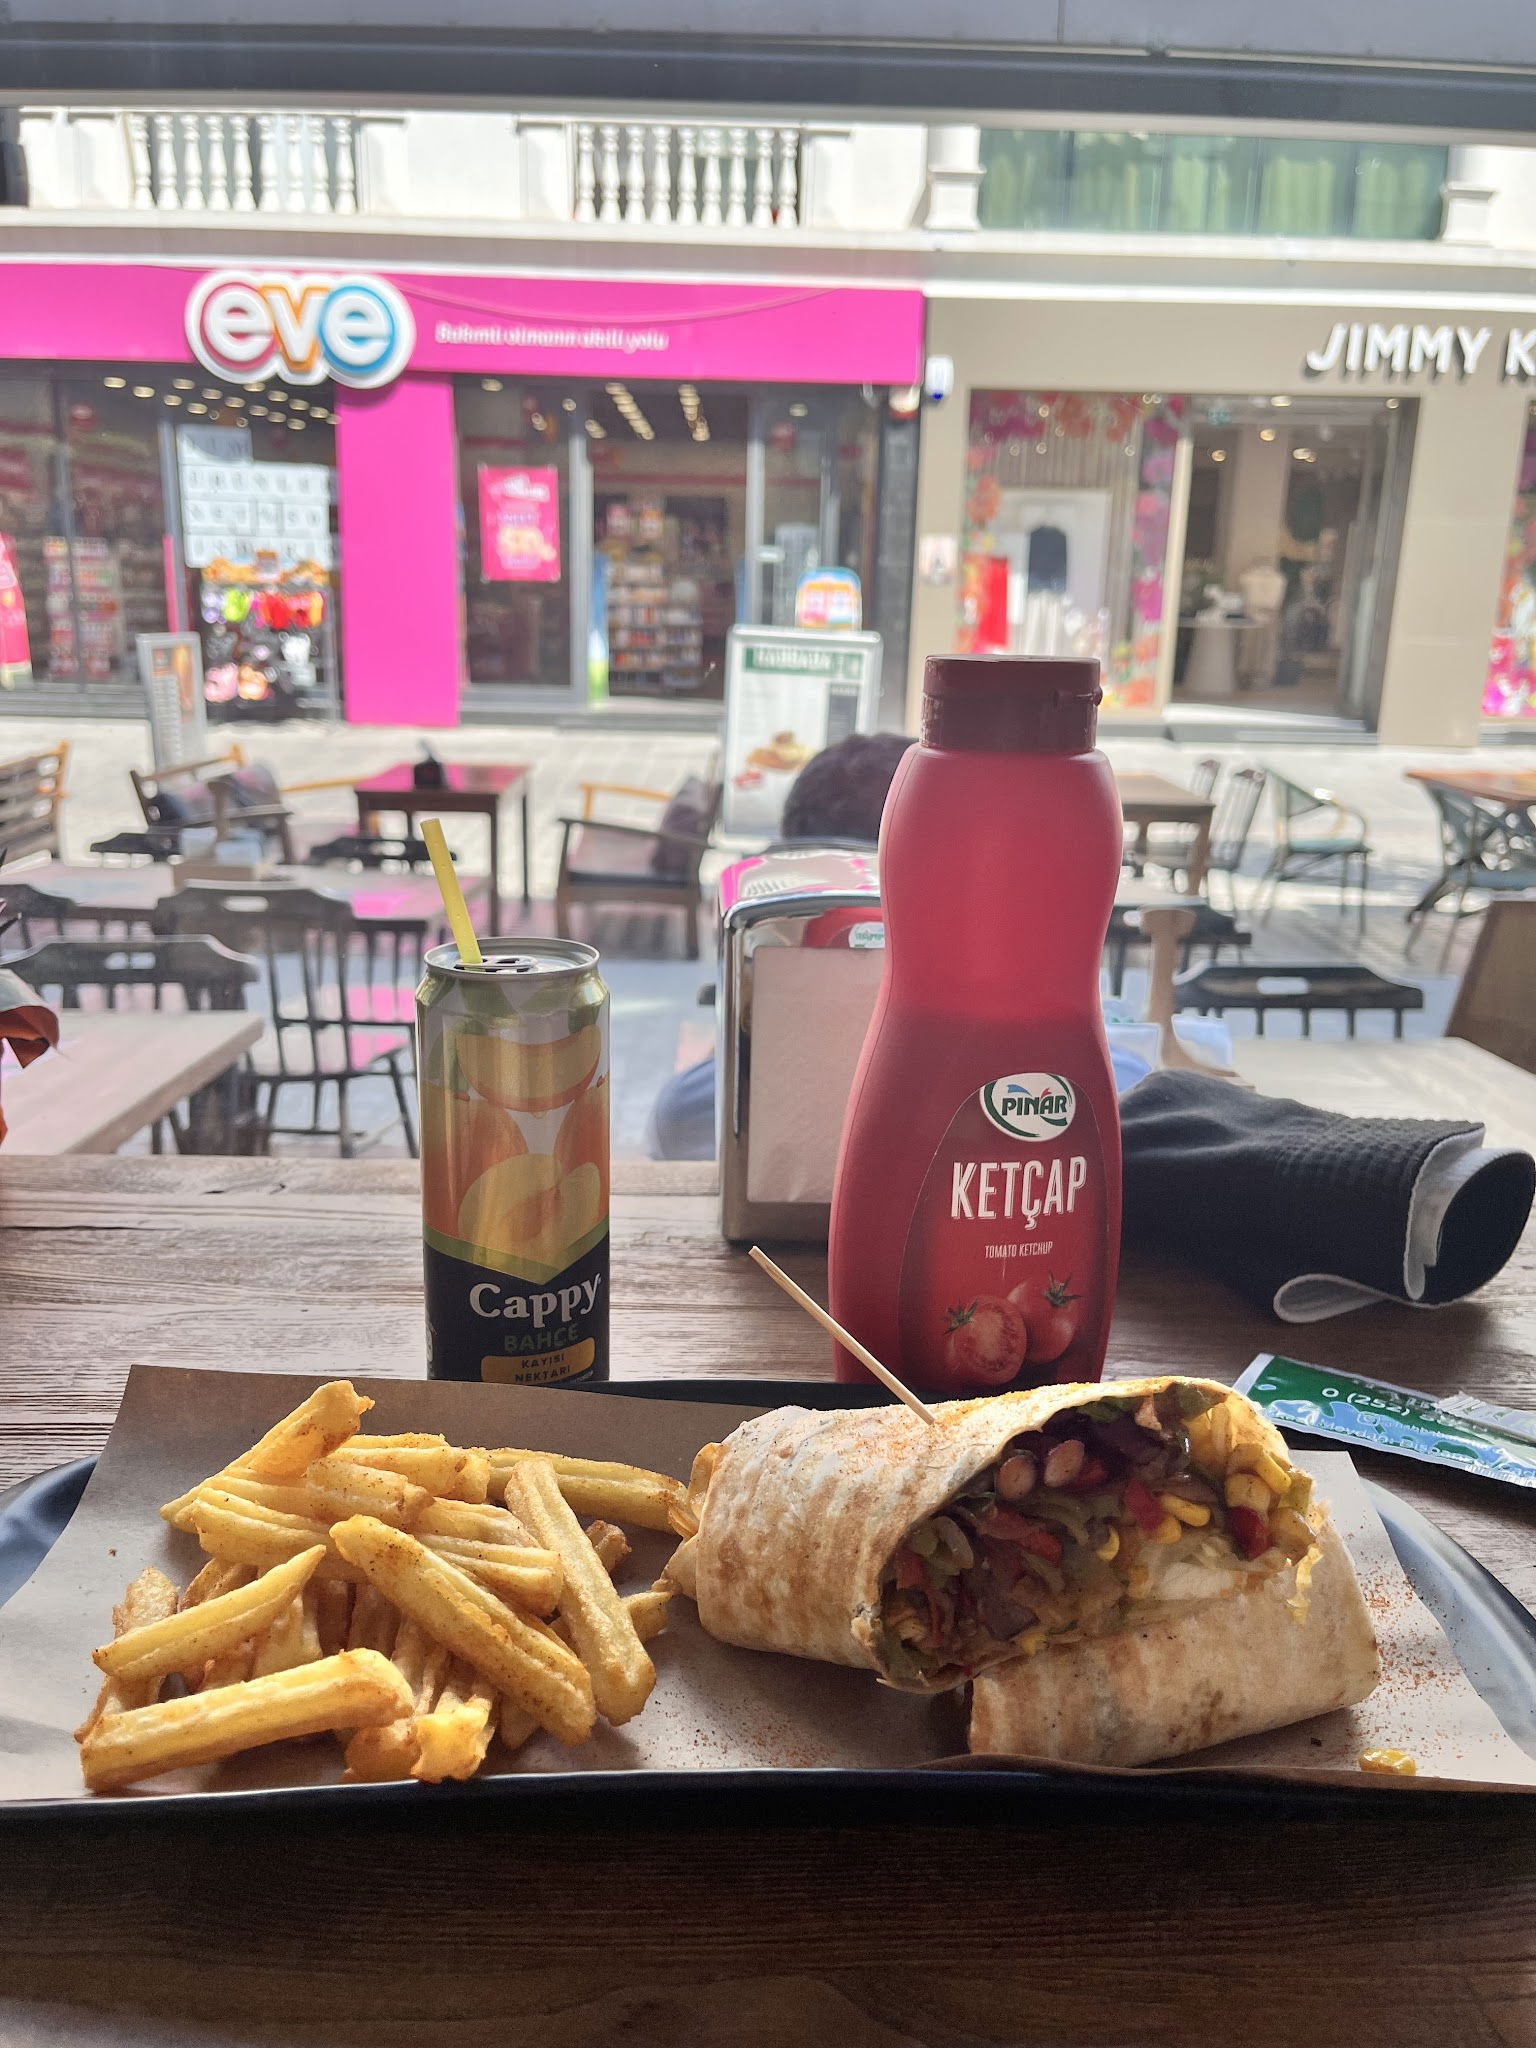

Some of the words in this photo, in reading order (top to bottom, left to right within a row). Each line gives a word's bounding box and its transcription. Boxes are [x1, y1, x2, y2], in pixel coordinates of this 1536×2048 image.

[200, 283, 395, 371] eve
[1306, 322, 1492, 374] JIMMY
[1002, 1093, 1067, 1116] PINAR
[951, 1155, 1087, 1230] KETÇAP
[985, 1244, 1017, 1258] TOMATO
[1019, 1241, 1053, 1257] KETCHUP
[469, 1273, 600, 1329] Cappy
[521, 1353, 565, 1369] KAYISI
[1347, 1393, 1410, 1416] (252)
